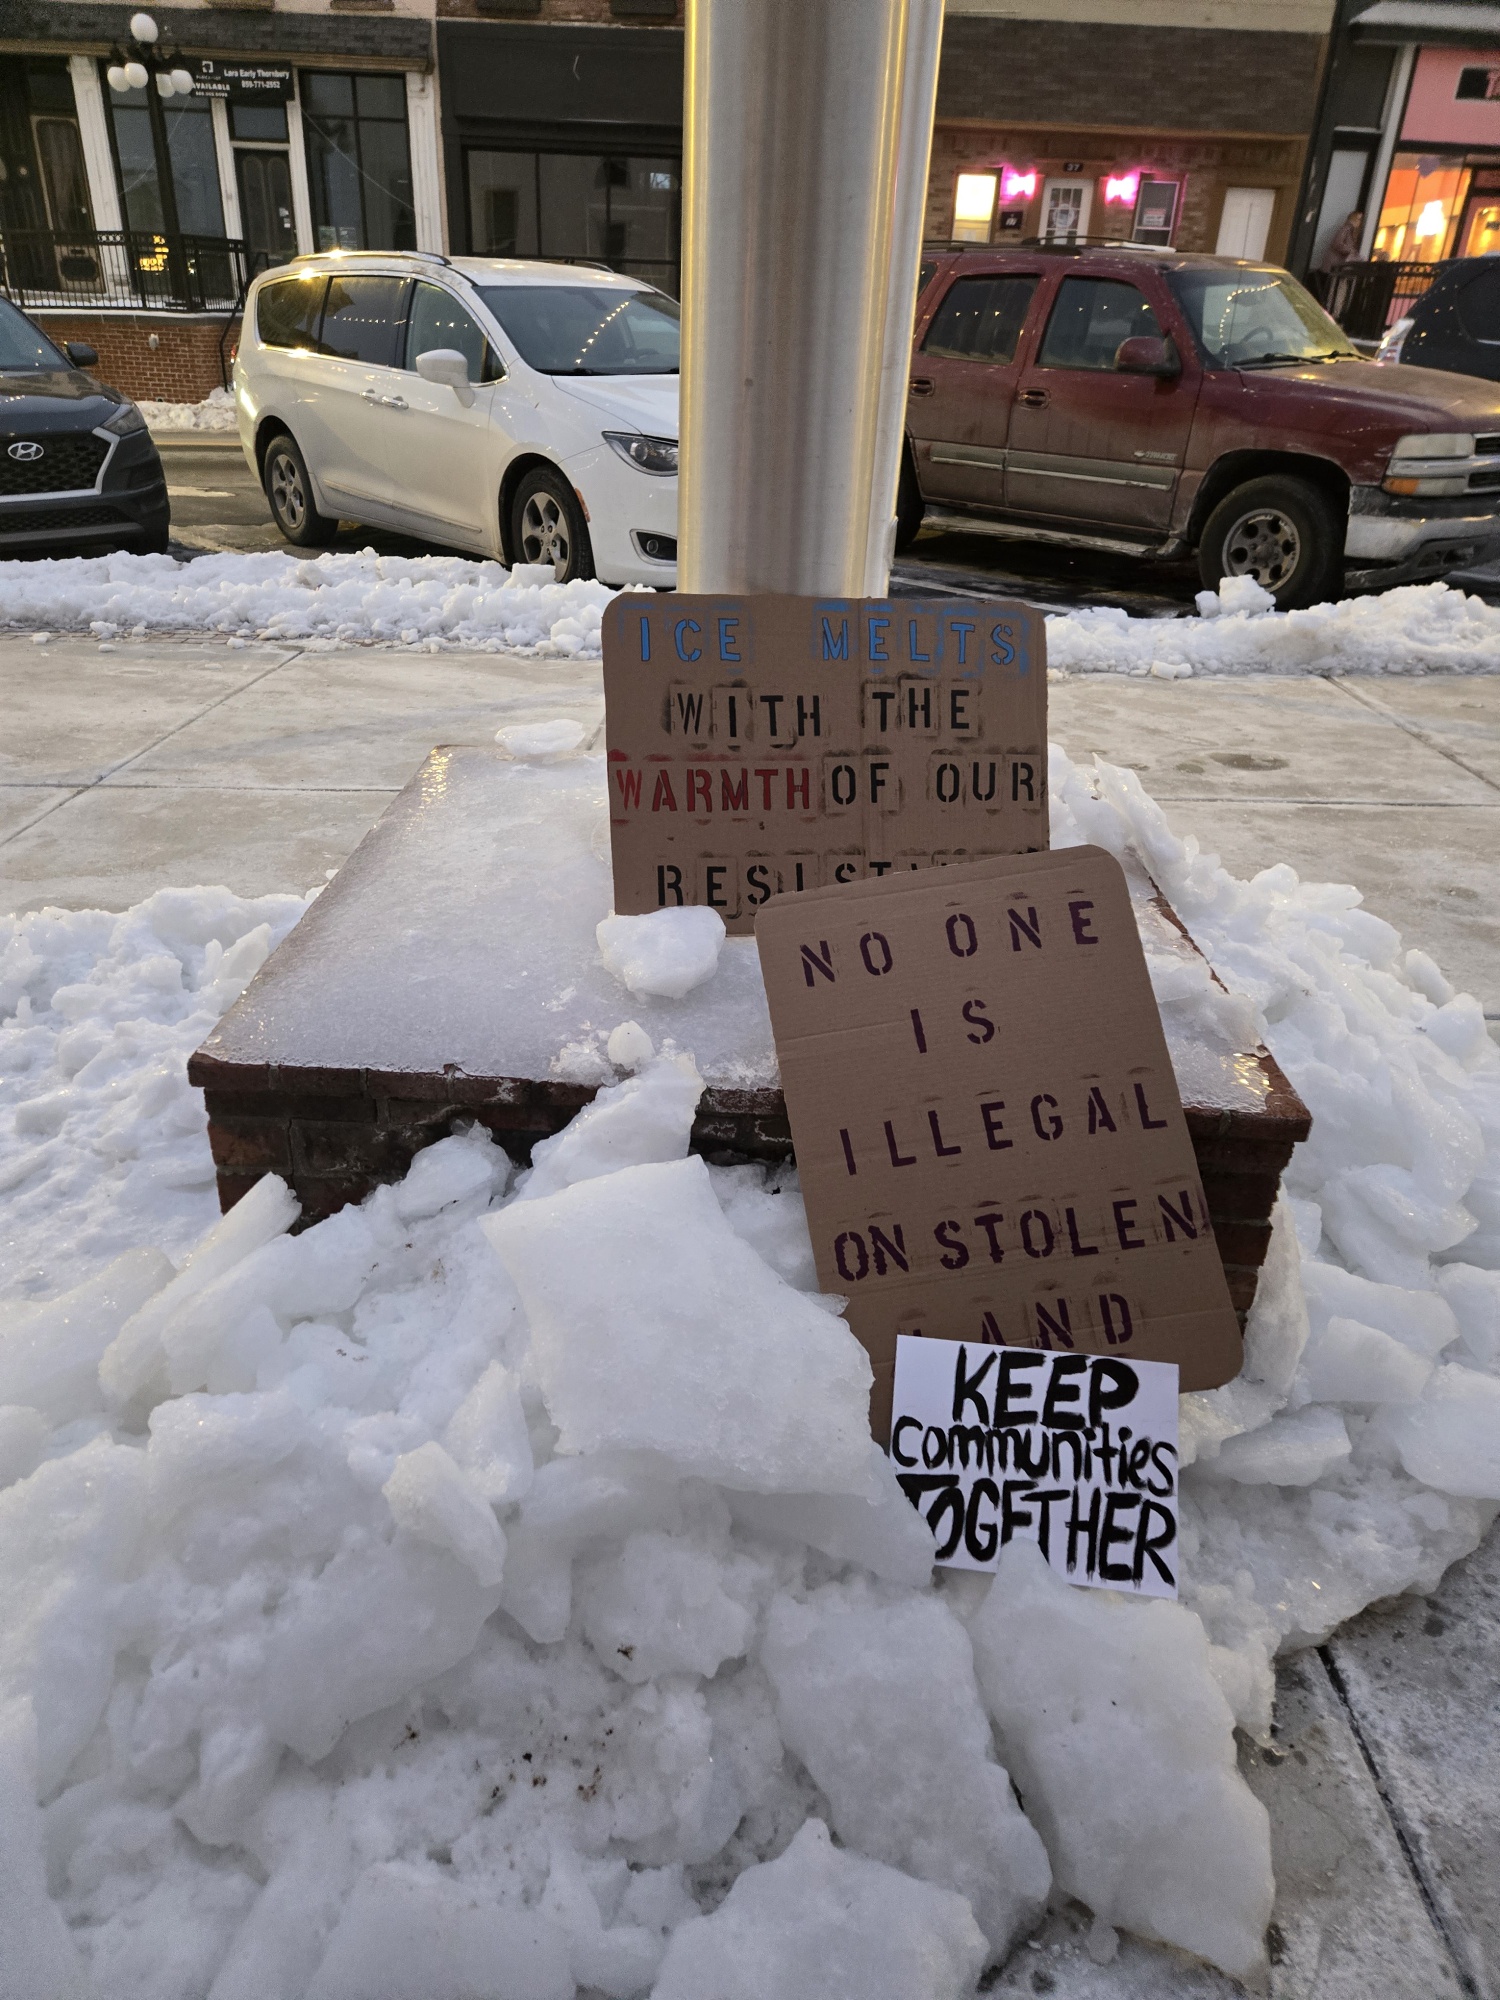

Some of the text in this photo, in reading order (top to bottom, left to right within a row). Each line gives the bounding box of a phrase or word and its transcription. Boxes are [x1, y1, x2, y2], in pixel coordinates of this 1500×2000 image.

[1066, 163, 1080, 171] 37
[639, 617, 1016, 665] ICE MELTS
[677, 688, 970, 737] WITH THE
[616, 761, 1034, 812] WARMTH OF OUR
[800, 901, 1100, 987] NO ONE
[910, 999, 996, 1053] IS
[839, 1083, 1168, 1176] ILLEGAL
[833, 1191, 1200, 1281] ON STOLEN
[912, 1293, 1133, 1349] AND
[952, 1344, 1139, 1430] KEEP
[896, 1474, 1177, 1588] TOGETHER
